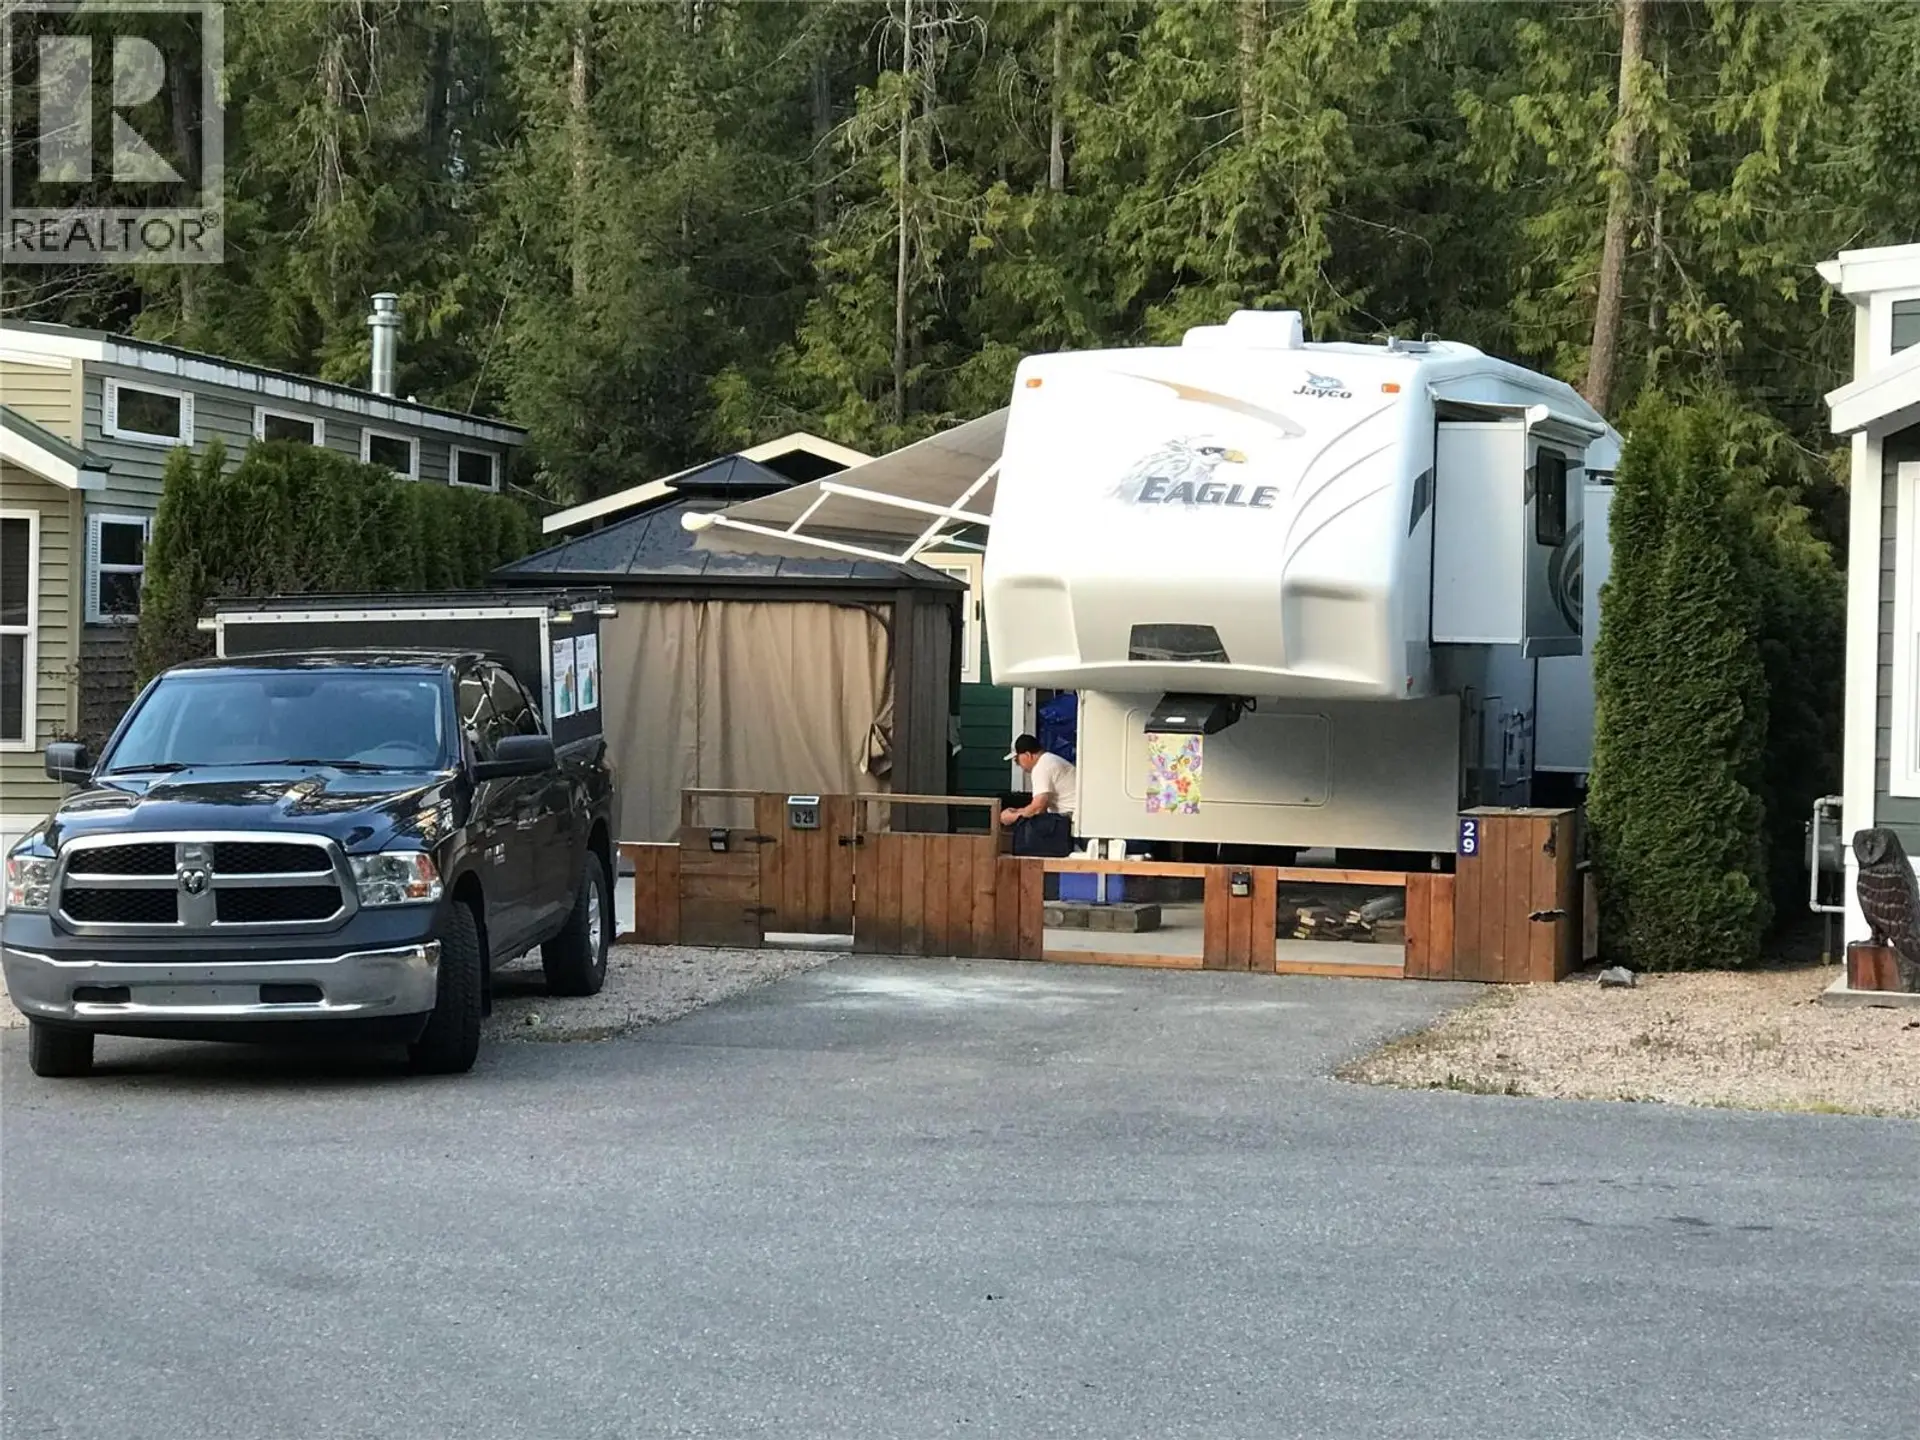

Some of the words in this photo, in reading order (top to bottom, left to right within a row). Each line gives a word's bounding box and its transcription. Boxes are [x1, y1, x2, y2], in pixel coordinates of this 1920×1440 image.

[1293, 385, 1352, 399] Jayco
[1138, 476, 1280, 509] EAGLE
[1462, 821, 1475, 853] 29
